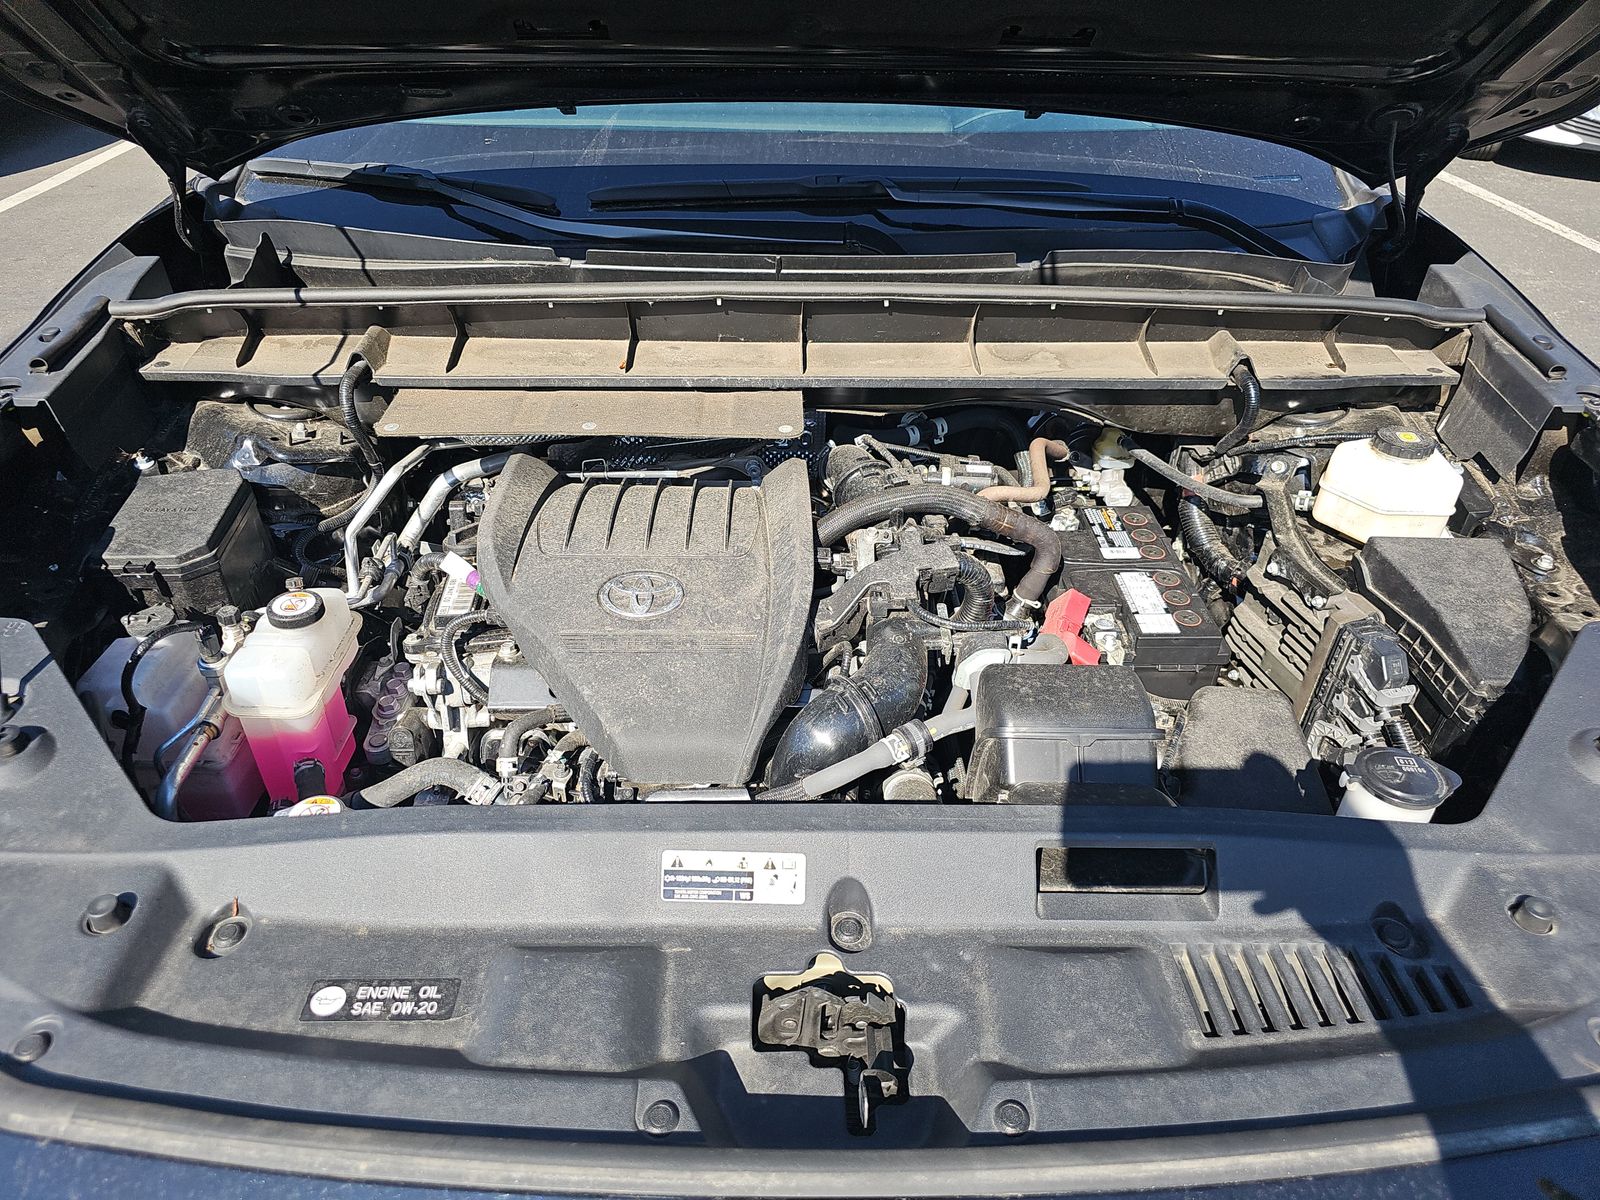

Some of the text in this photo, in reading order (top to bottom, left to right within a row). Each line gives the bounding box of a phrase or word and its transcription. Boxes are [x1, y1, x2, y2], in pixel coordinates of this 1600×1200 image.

[356, 985, 442, 999] ENGINE OIL
[352, 1001, 438, 1016] SAE 0W-20
